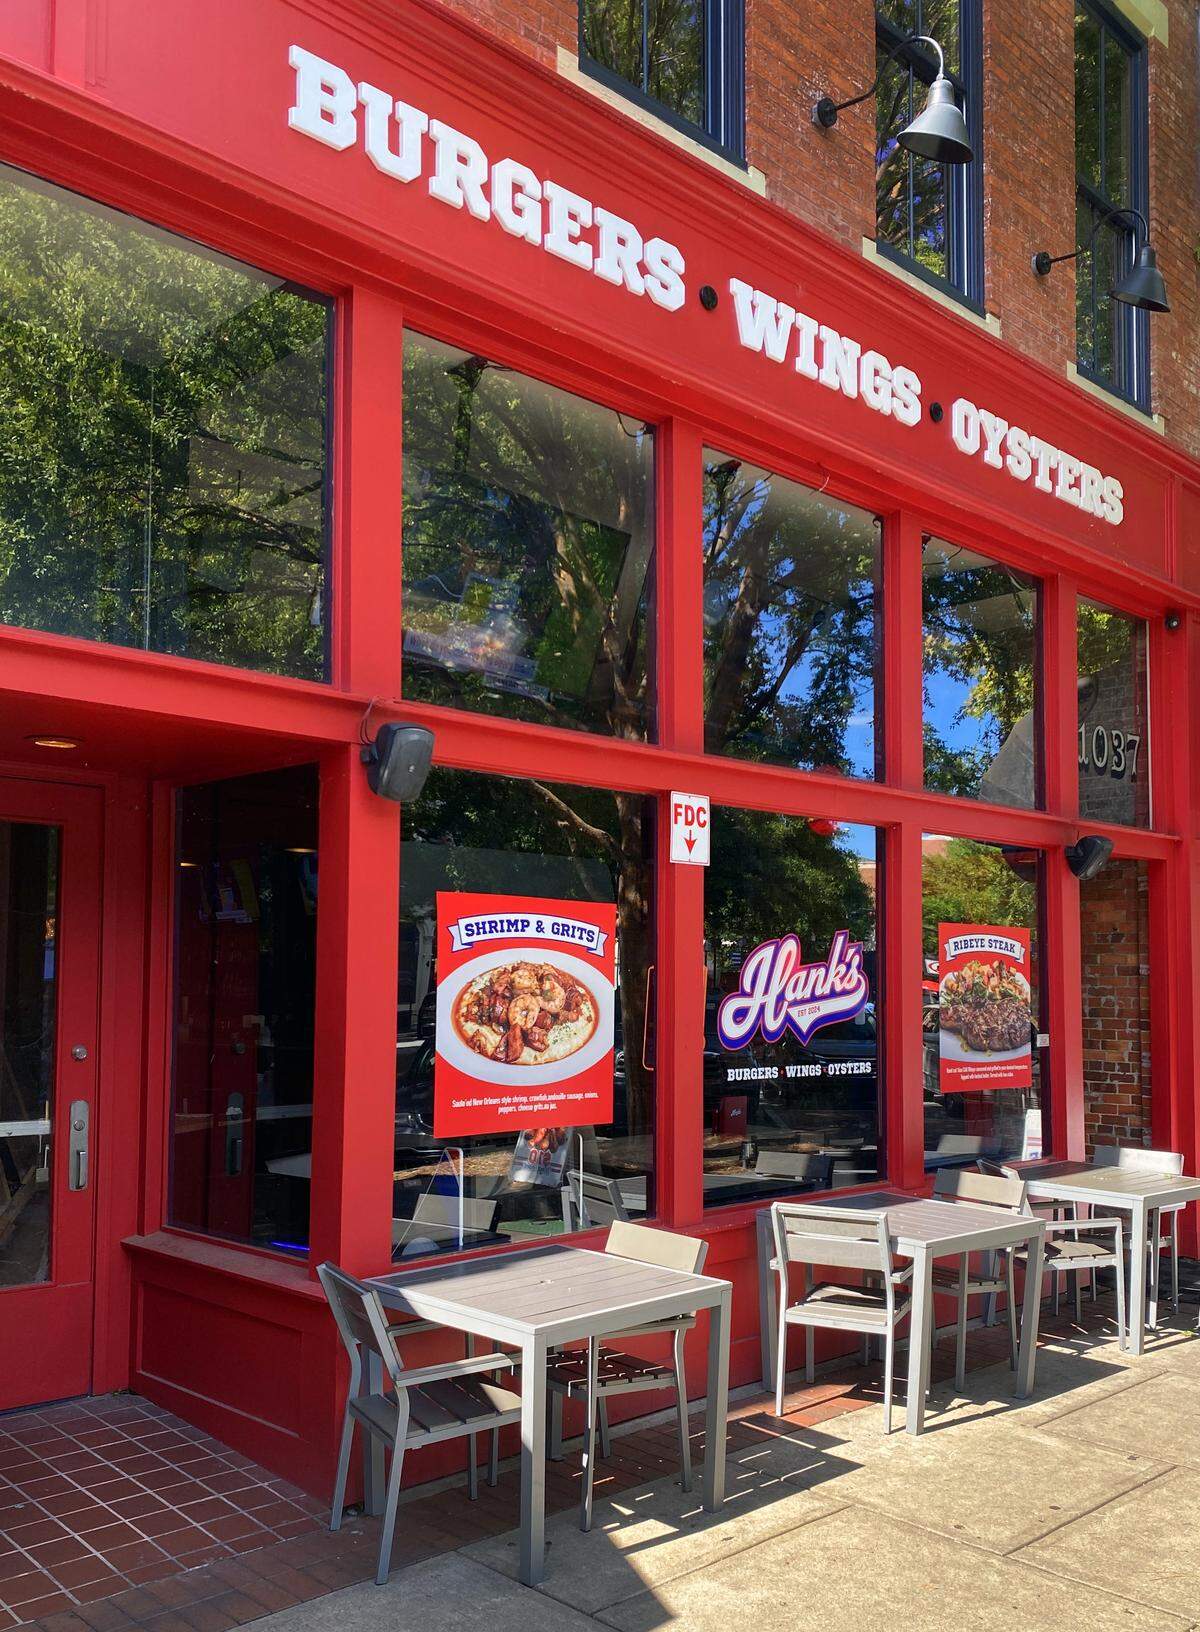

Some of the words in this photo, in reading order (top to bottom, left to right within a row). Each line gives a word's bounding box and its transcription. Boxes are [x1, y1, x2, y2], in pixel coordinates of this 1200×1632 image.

[288, 44, 686, 312] BURGERS
[729, 277, 921, 427] WINGS
[952, 397, 1124, 526] OYSTERS
[1078, 721, 1140, 780] 1037
[674, 803, 707, 828] FDC
[464, 919, 530, 937] SHRIMP
[535, 920, 545, 934] &
[551, 921, 595, 943] GRITS
[953, 938, 985, 952] RIBEYE
[988, 938, 1016, 954] STEAK
[719, 931, 867, 1045] Hank's
[727, 1067, 779, 1081] BURGERS
[785, 1064, 822, 1078] WINGS
[827, 1061, 872, 1075] OYSTERS
